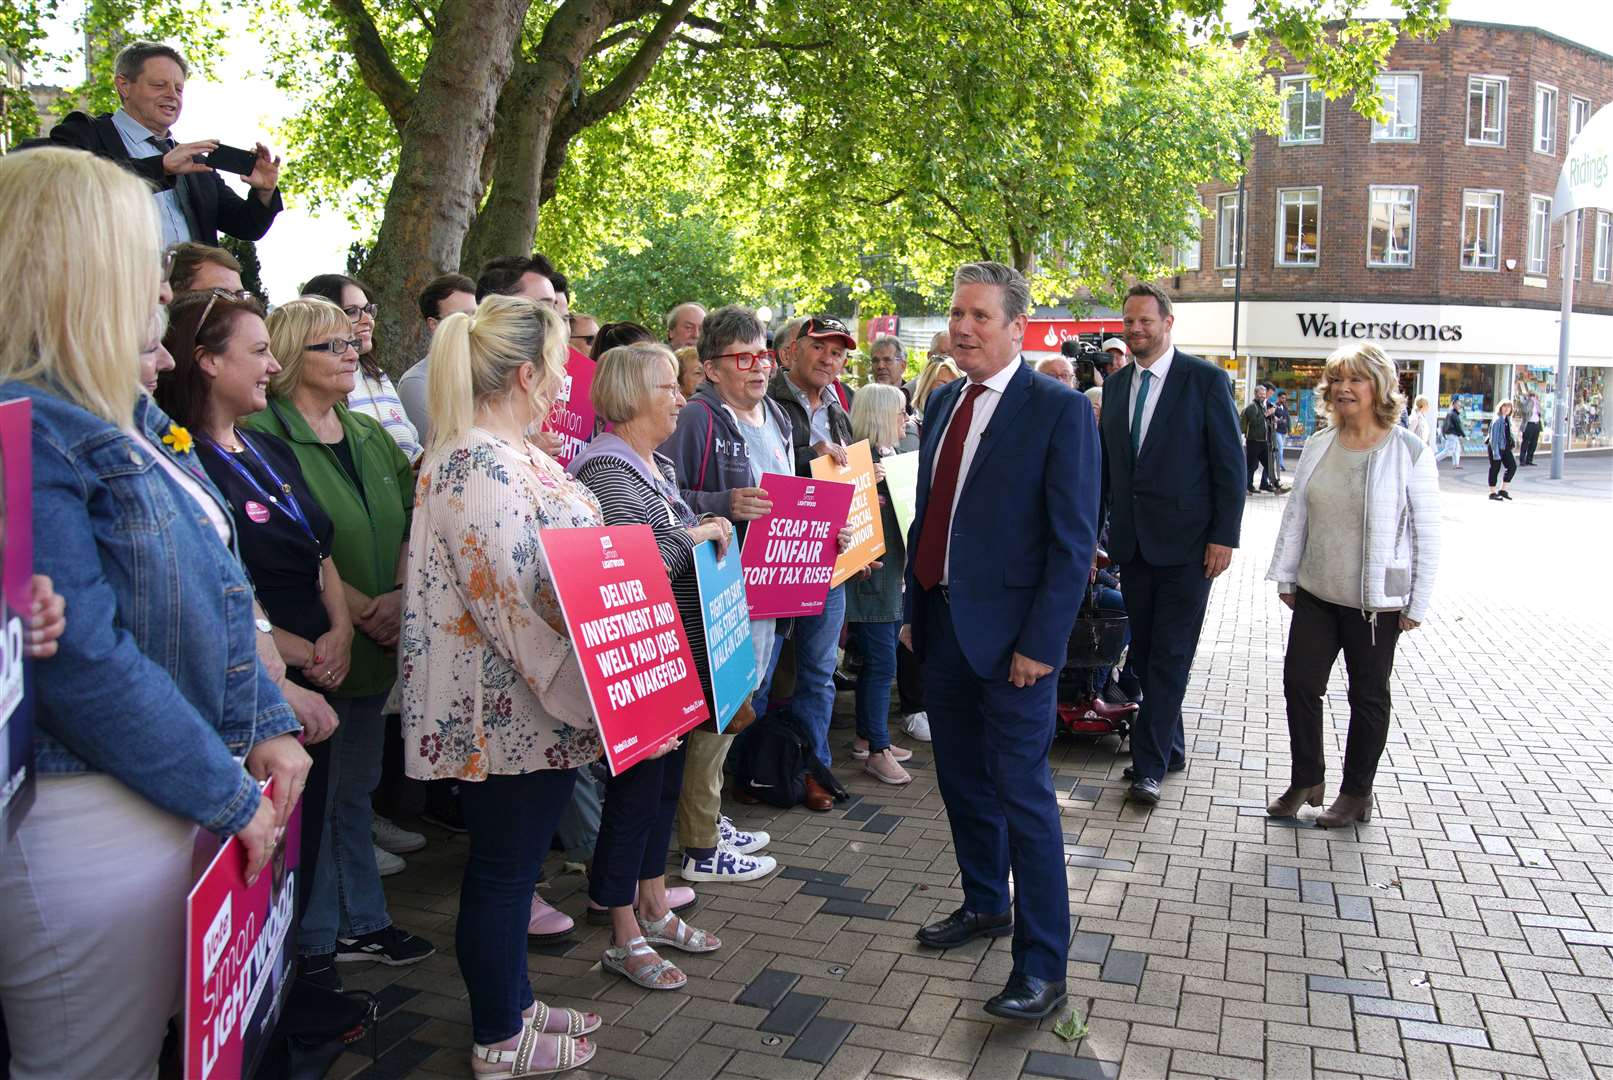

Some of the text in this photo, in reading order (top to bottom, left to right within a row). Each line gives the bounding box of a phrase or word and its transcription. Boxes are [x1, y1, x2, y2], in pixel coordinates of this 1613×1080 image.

[1569, 153, 1608, 188] Ridings
[1296, 312, 1463, 341] Waterstones
[550, 402, 582, 433] Simon
[768, 517, 831, 539] SCRAP THE
[764, 539, 823, 564] UNFAIR
[599, 579, 648, 609] DELIVER
[743, 567, 778, 586] TORY
[778, 566, 803, 585] TAX
[802, 566, 833, 584] RISES
[709, 580, 742, 622] FIGHT TO SAVE
[580, 602, 675, 648] INVESTMENT AND
[709, 620, 724, 649] KING
[722, 606, 740, 634] STREET
[712, 619, 750, 672] WALK-IN CENTRE
[595, 629, 681, 678] WELL PAID JOBS
[606, 657, 687, 711] FOR WAKEFIELD
[206, 913, 229, 960] Vote
[202, 871, 294, 1080] LIGHTWOOD
[203, 911, 255, 1025] Simon
